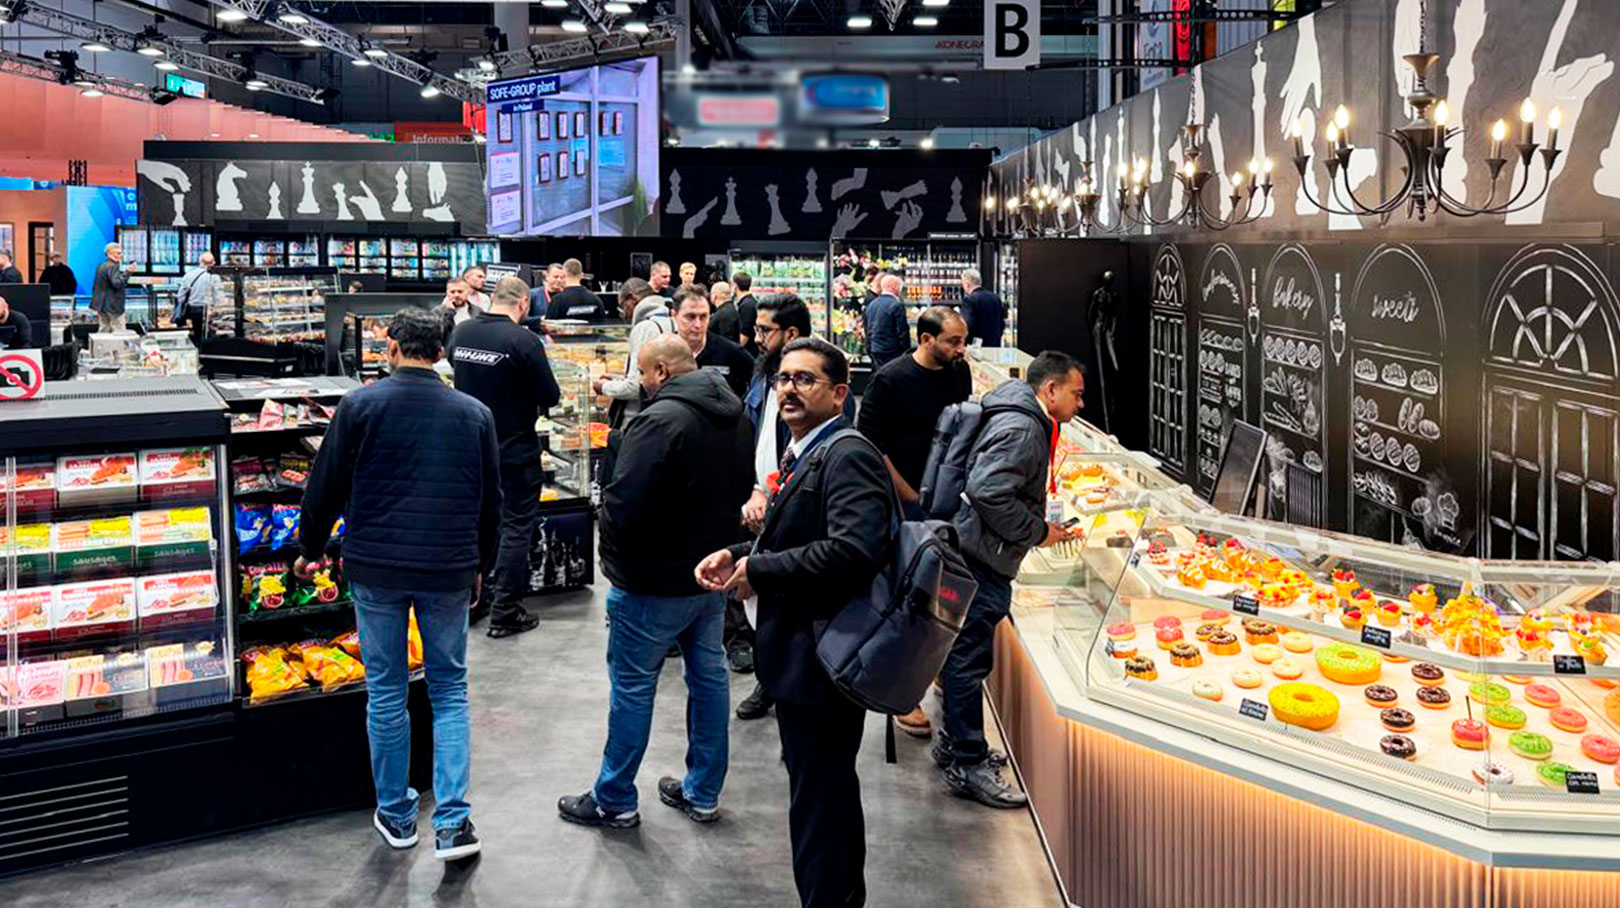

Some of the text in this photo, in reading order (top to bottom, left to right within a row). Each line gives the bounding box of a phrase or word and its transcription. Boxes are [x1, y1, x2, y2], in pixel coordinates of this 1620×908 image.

[995, 3, 1030, 58] B
[489, 80, 556, 100] SOFE-GROUP plant
[72, 555, 118, 566] sausages
